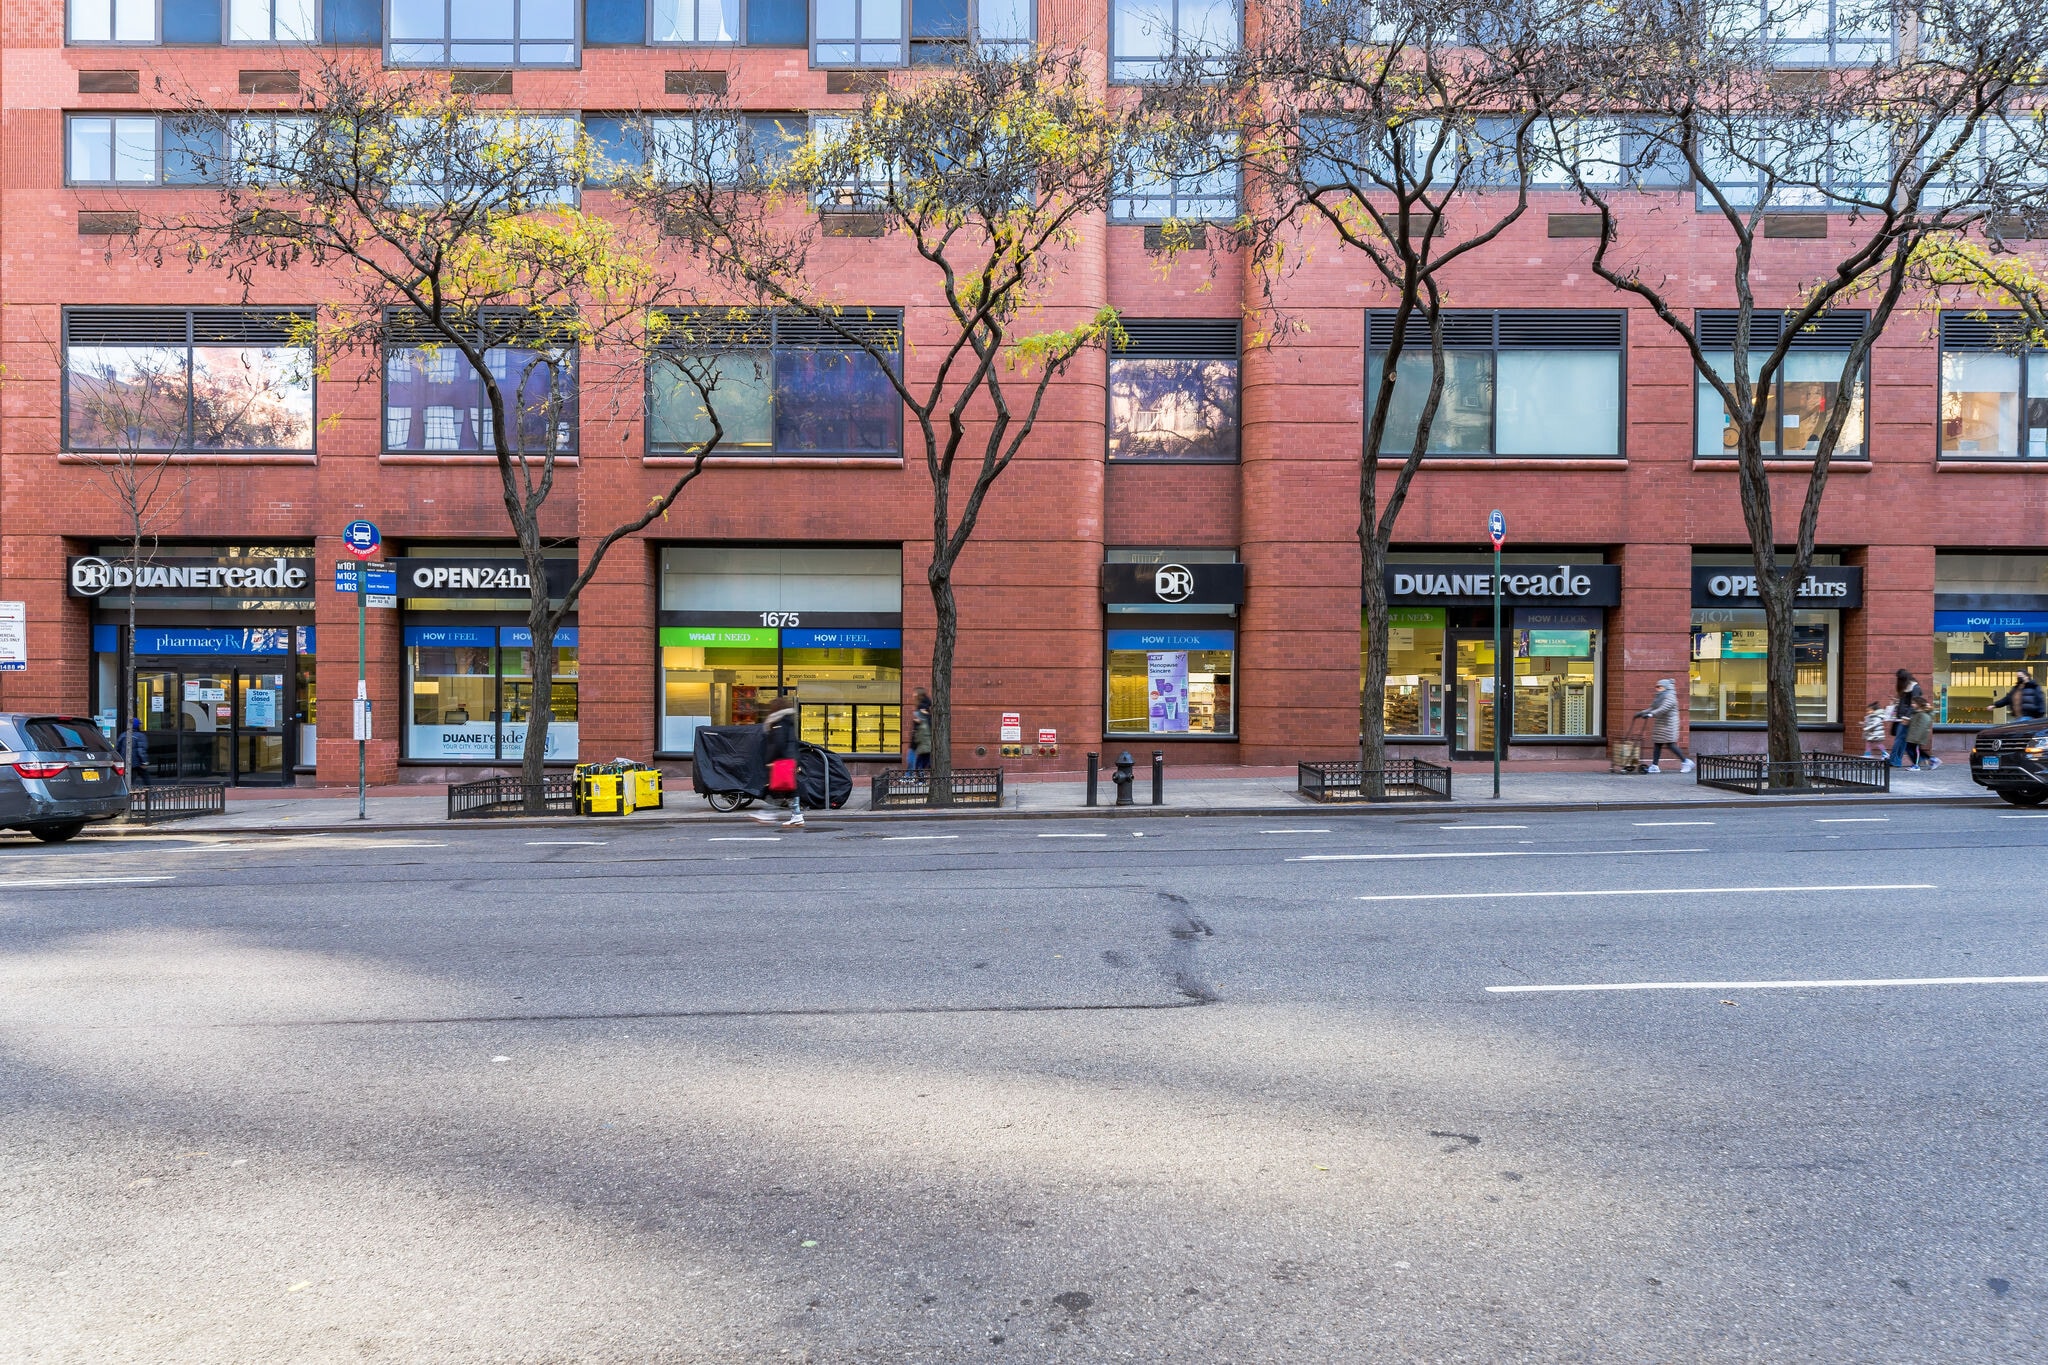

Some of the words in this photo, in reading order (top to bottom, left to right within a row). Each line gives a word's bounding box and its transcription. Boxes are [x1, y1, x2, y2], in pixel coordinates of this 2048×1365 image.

[337, 562, 356, 571] M101
[337, 572, 357, 580] M102
[337, 583, 357, 591] M103
[760, 612, 800, 627] 1675
[1967, 617, 1991, 625] HOW
[1993, 617, 1997, 625] I
[1999, 617, 2024, 626] FEEL
[689, 633, 716, 641] WHAT
[719, 633, 723, 641] I
[724, 633, 751, 641] NEED
[814, 634, 837, 642] HOW
[839, 634, 844, 642] I
[845, 634, 870, 642] FEEL
[1141, 636, 1165, 644] HOW
[1167, 636, 1170, 644] I
[1171, 636, 1200, 644] LOOK
[156, 633, 224, 650] pharmacy
